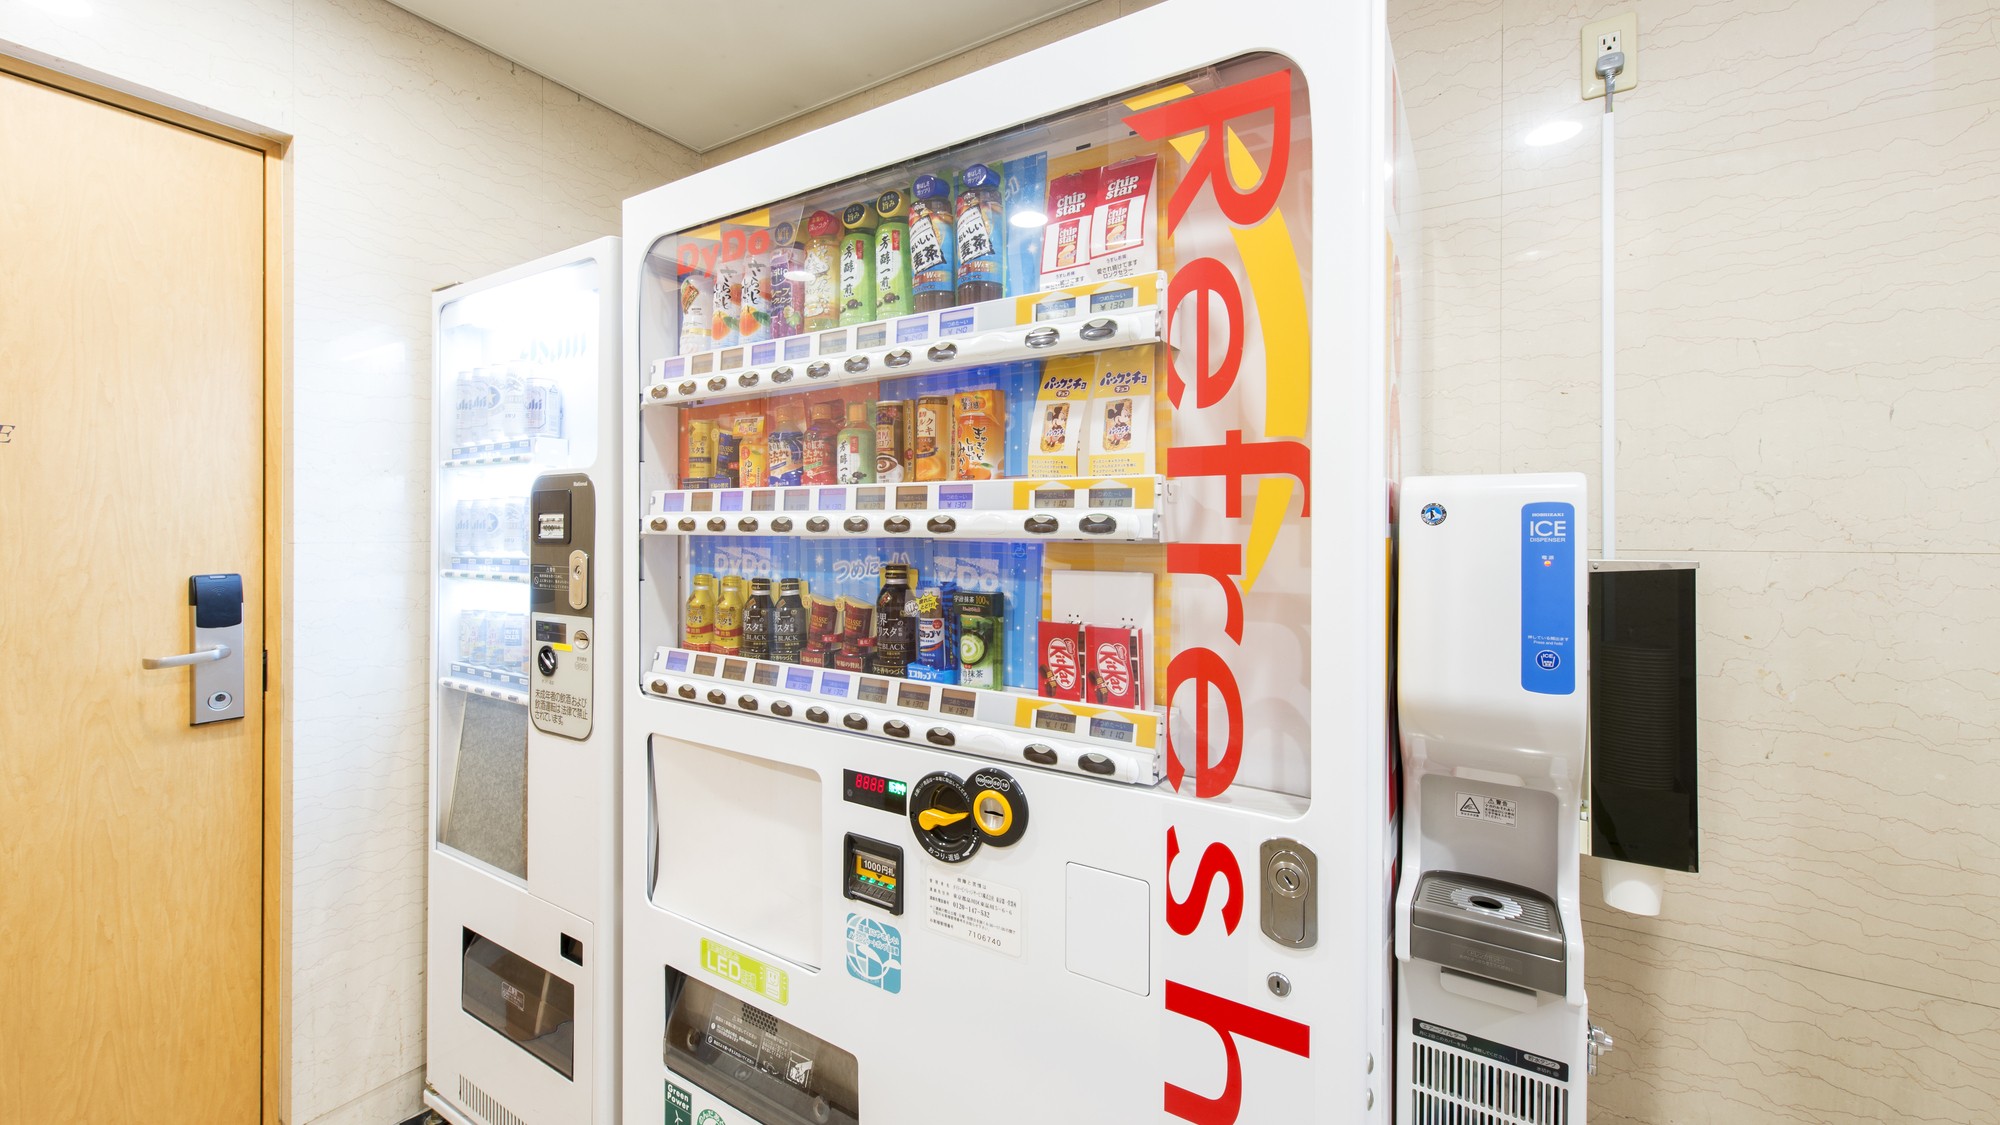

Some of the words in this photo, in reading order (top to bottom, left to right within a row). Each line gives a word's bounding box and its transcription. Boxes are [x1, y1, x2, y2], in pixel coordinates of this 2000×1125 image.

[1106, 184, 1138, 200] star
[1108, 176, 1139, 191] chip
[1057, 192, 1086, 208] chip
[1056, 202, 1085, 218] star
[958, 222, 983, 243] おいしい
[911, 233, 934, 252] おいしい
[960, 233, 987, 258] 麦茶
[676, 229, 771, 278] DyDo
[913, 244, 940, 267] 麦茶
[1044, 376, 1086, 390] パックンチョ
[1100, 371, 1147, 386] パックンチョ
[1530, 520, 1566, 537] ICE
[1122, 68, 1311, 1125] Refresh
[535, 689, 588, 708] 未成年者の飲酒および
[968, 930, 1001, 947] 7106740
[707, 951, 740, 981] LED
[667, 1084, 689, 1101] Green
[667, 1093, 690, 1111] Power
